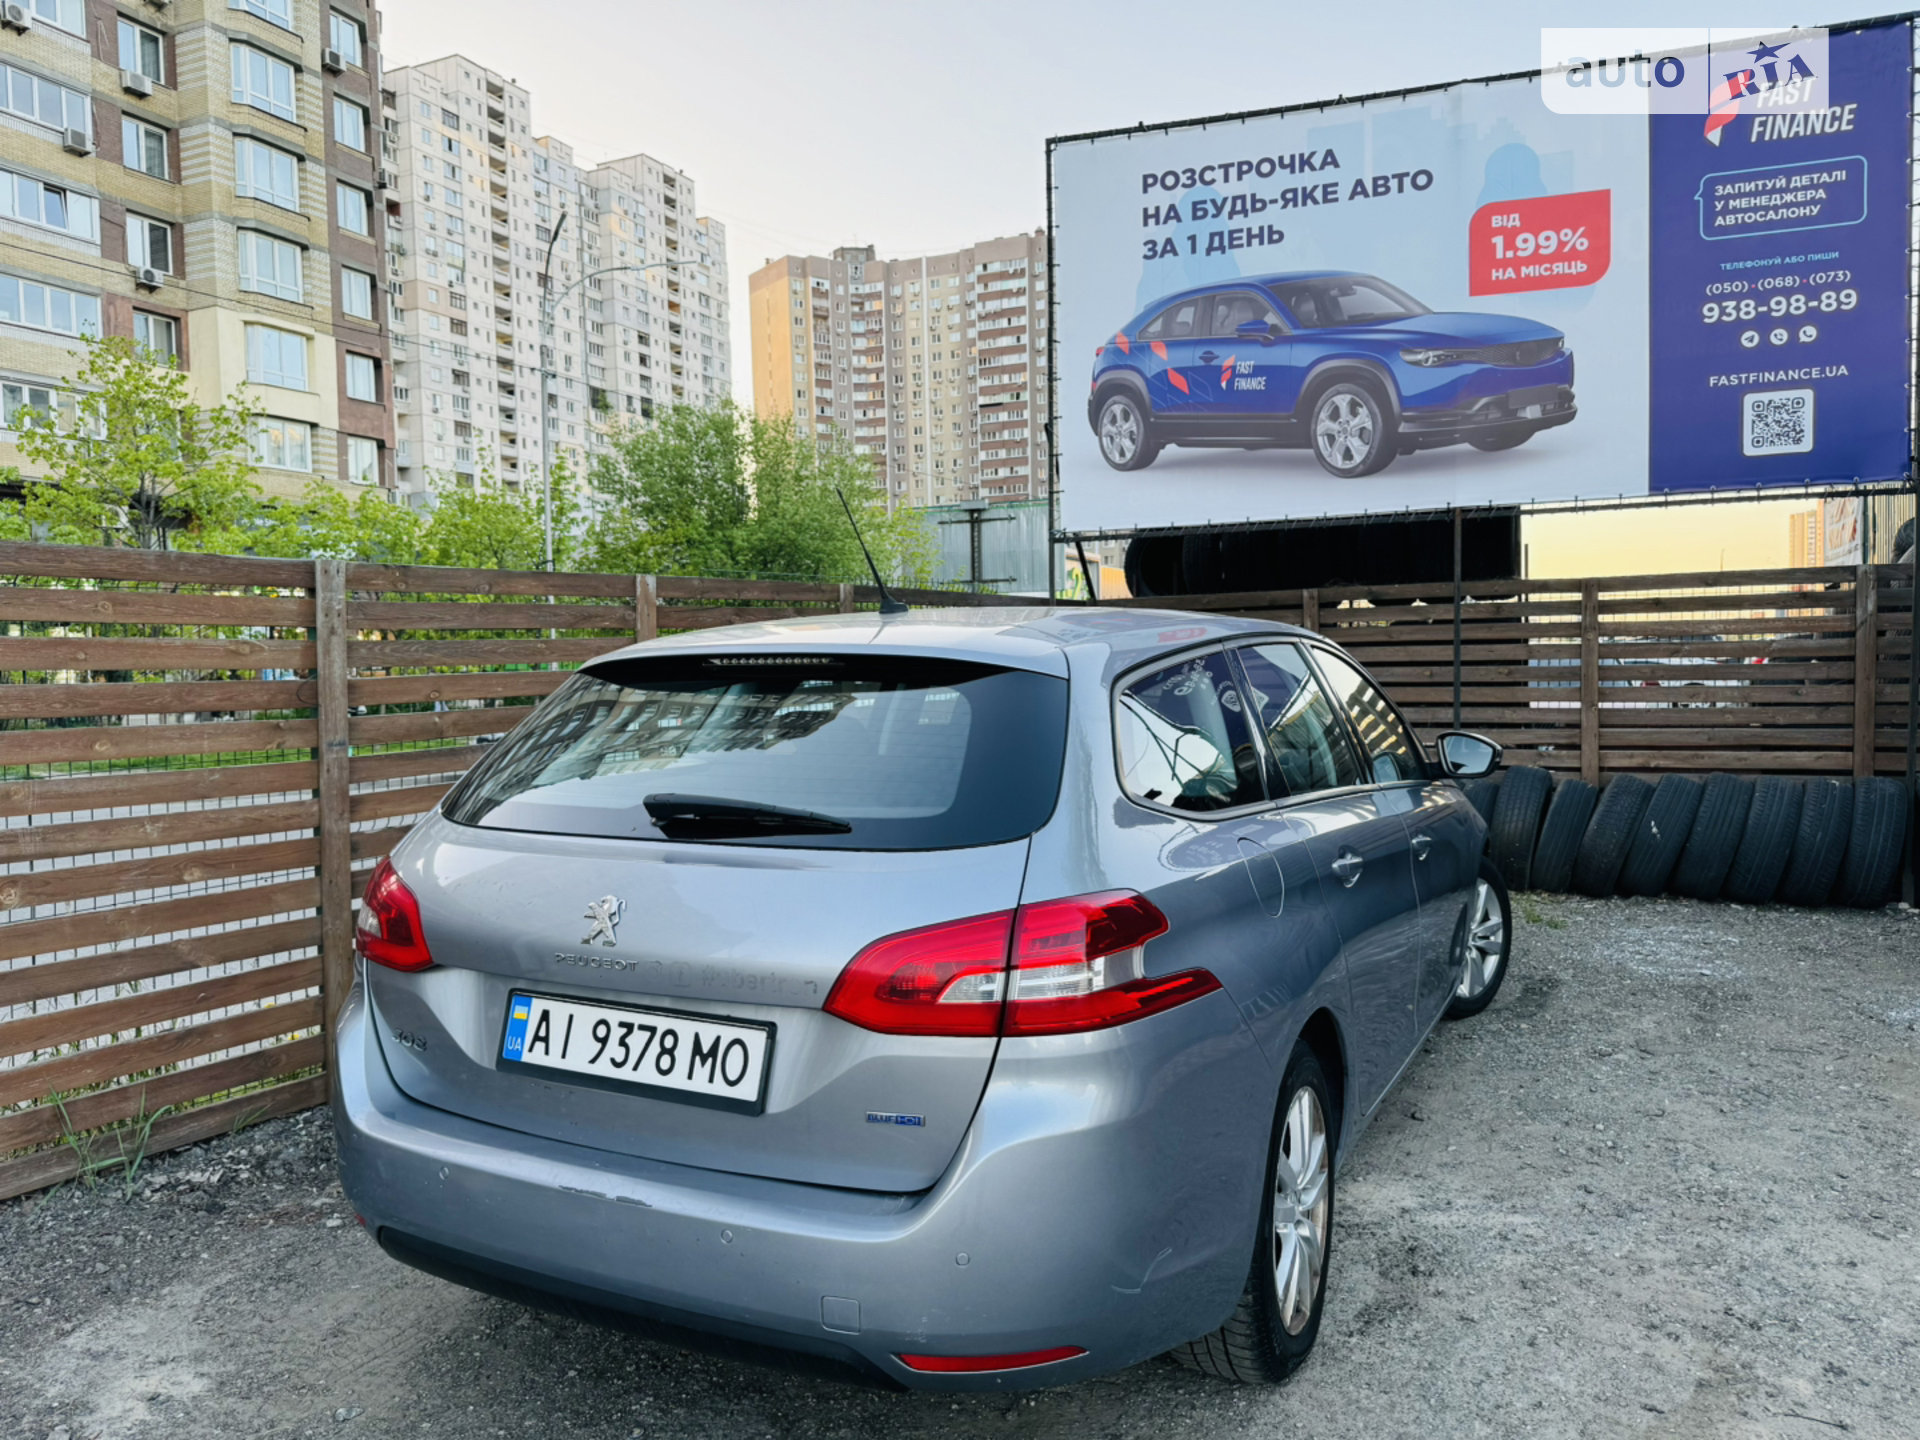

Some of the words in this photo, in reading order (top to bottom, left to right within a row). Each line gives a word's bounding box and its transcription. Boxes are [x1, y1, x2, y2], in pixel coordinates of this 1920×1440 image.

[1757, 77, 1817, 108] FAST
[1751, 104, 1857, 143] FINANCE
[1142, 149, 1340, 194] РОЗСТРОЧКА
[1714, 175, 1786, 196] ЗАПИТУЙ
[1790, 170, 1846, 188] ДЕТАЛІ
[1142, 203, 1182, 227] НА
[1191, 182, 1339, 221] БУДЬ-ЯКЕ
[1348, 169, 1434, 201] АВТО
[1715, 200, 1725, 212] У
[1729, 189, 1827, 210] МЕНЕДЖЕРА
[1491, 213, 1521, 228] ВІД
[1714, 204, 1821, 227] АВТОСАЛОНУ
[1142, 237, 1179, 260] ЗА
[1187, 235, 1198, 255] 1
[1206, 224, 1285, 256] ДЕНЬ
[1491, 226, 1589, 260] 1.99%
[1491, 267, 1516, 281] НА
[1521, 260, 1588, 278] МІСЯЦЬ
[1720, 256, 1781, 271] ТЕЛЕФОНУЙ
[1784, 255, 1805, 264] АБО
[1808, 251, 1839, 262] ПИШИ
[1706, 281, 1749, 296] (050)
[1757, 276, 1800, 291] (068)
[1809, 270, 1851, 286] (073)
[1702, 288, 1858, 324] 938-98-89
[1236, 361, 1254, 374] FAST
[1709, 364, 1849, 387] FASTFINANCE.UA
[1234, 377, 1267, 391] FINANCE
[555, 952, 639, 972] PEUGEOT
[507, 1036, 522, 1051] UA
[528, 1009, 574, 1059] AI
[588, 1018, 679, 1077] 9378
[687, 1031, 750, 1087] MO
